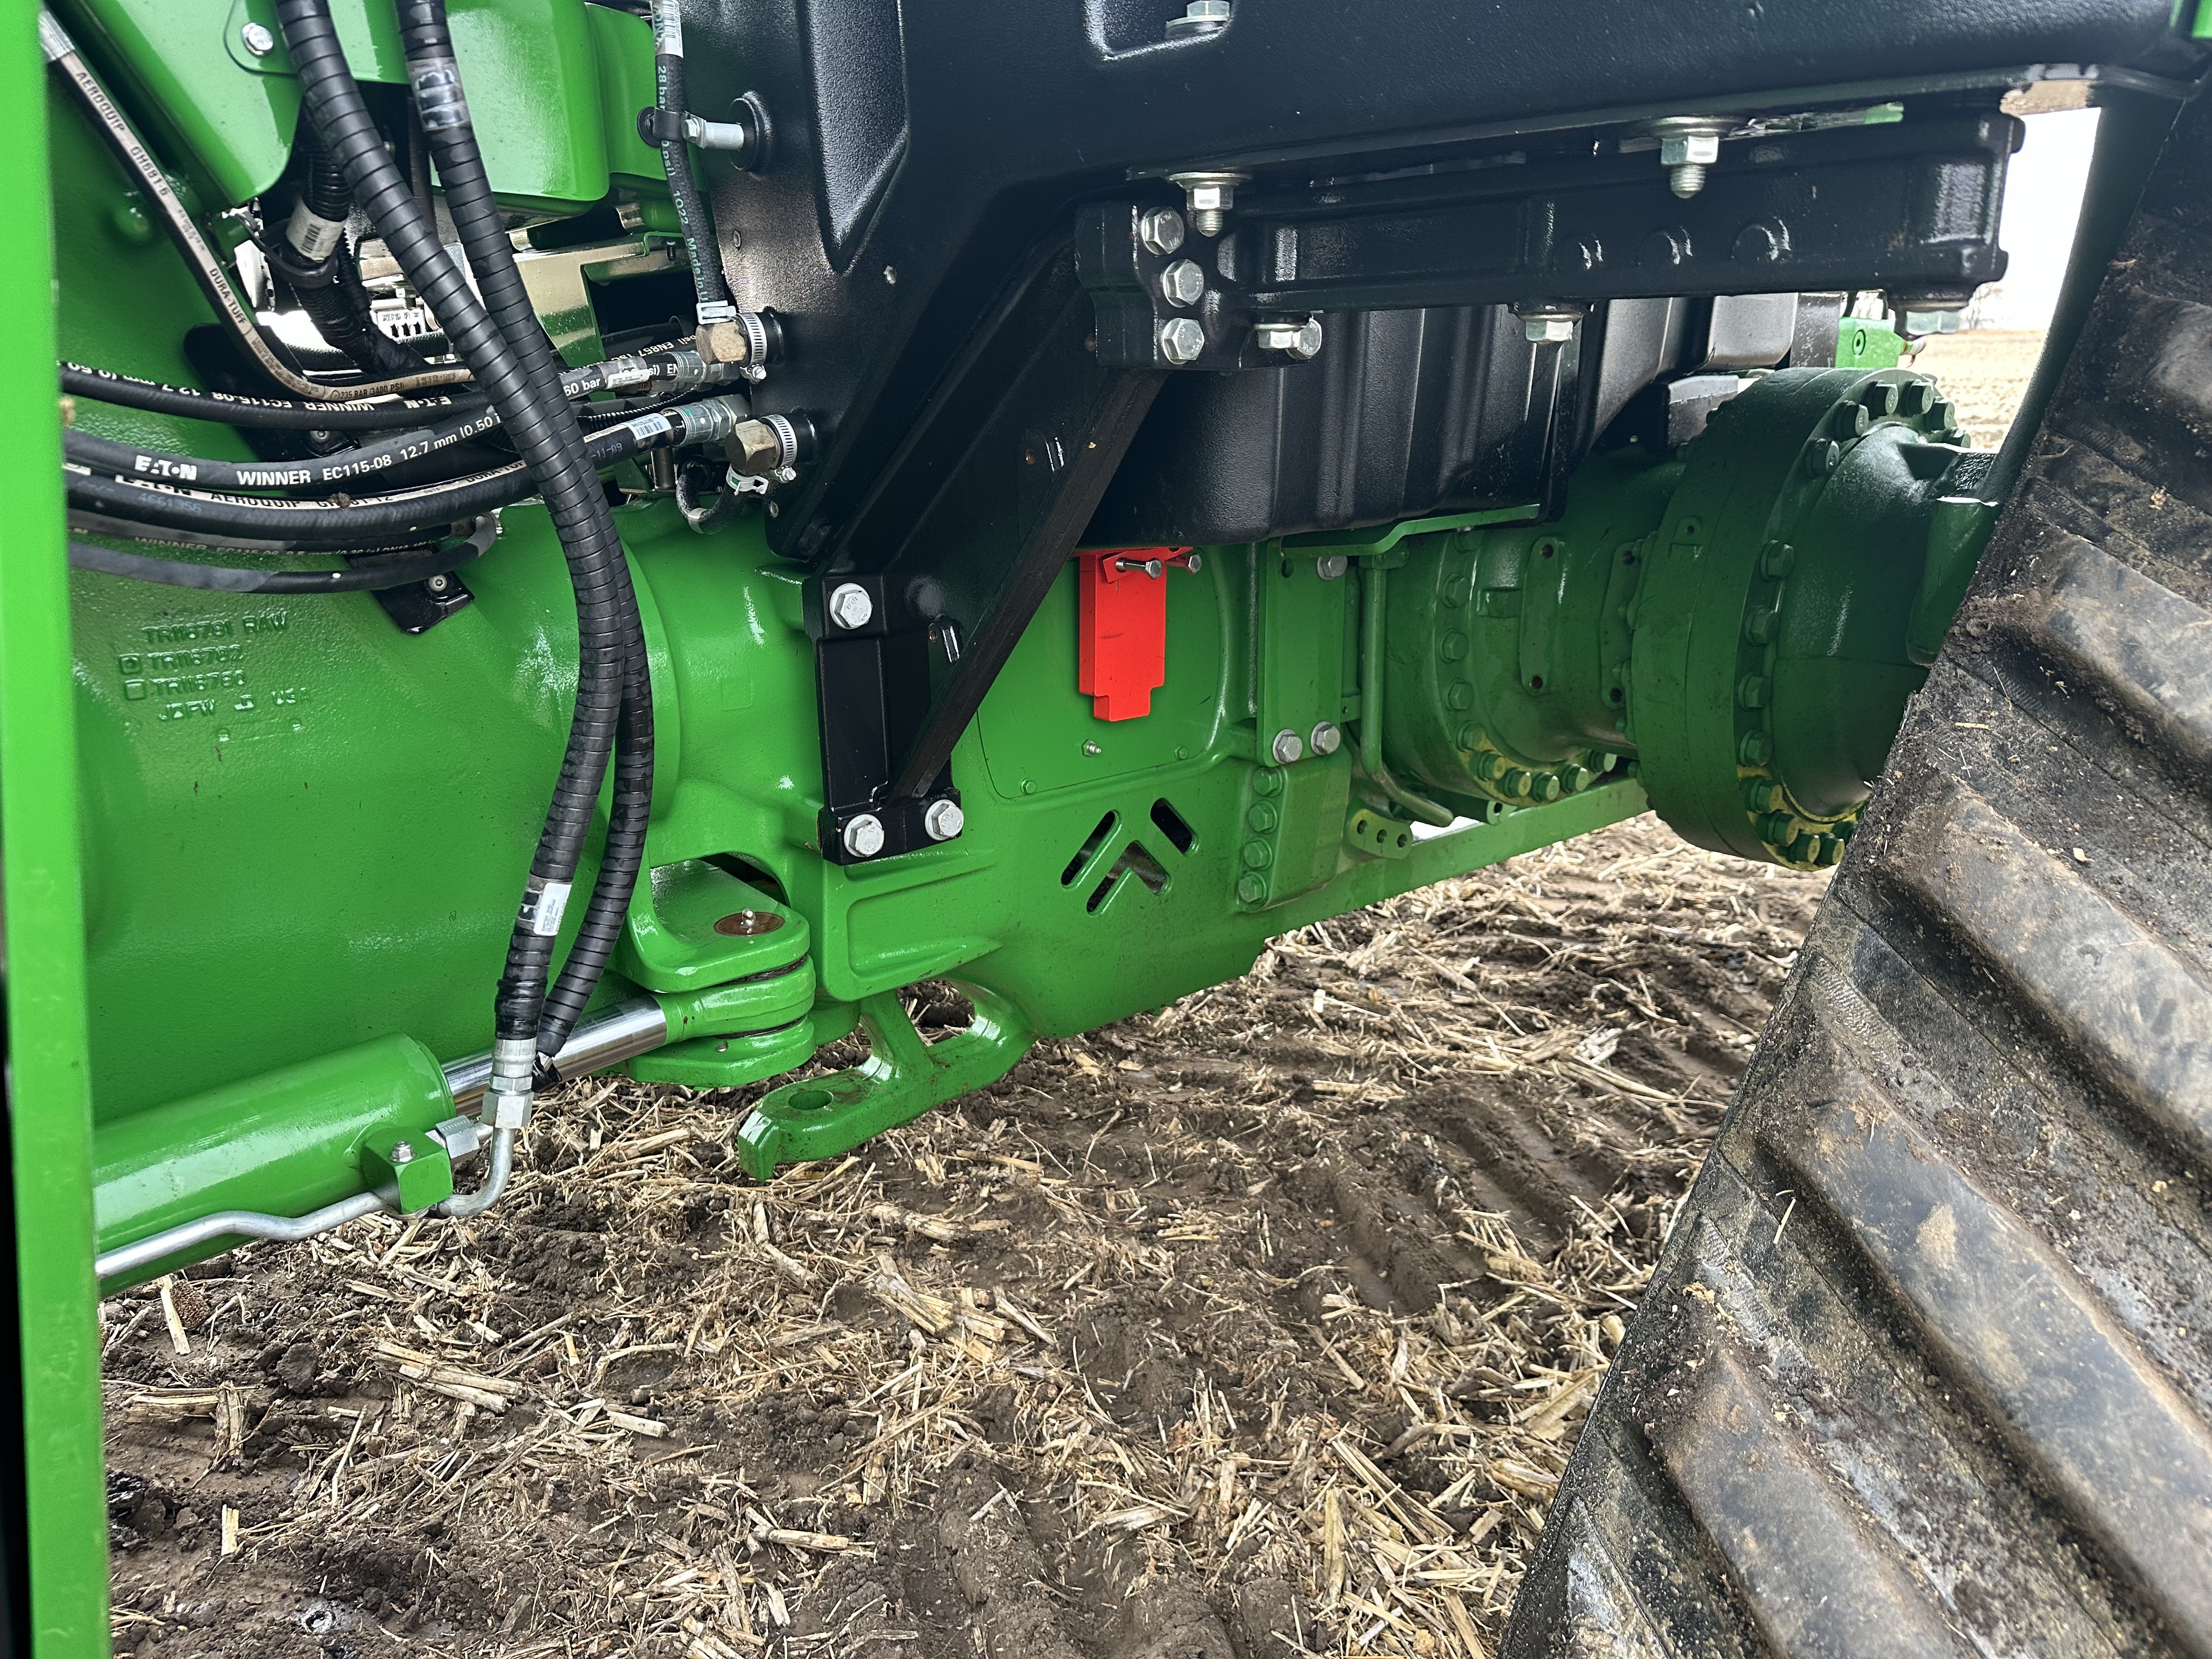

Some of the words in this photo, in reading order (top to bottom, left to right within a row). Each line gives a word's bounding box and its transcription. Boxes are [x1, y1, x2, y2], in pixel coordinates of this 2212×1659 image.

[658, 65, 667, 83] 28
[687, 237, 702, 275] Made
[696, 276, 705, 289] in
[76, 71, 126, 132] AEROQUIP
[209, 267, 247, 325] DURA-TUFF
[637, 341, 675, 357] EN857
[340, 391, 353, 399] 235
[354, 388, 368, 398] BAR
[581, 378, 601, 391] bar
[303, 401, 375, 411] WINNER
[236, 469, 312, 486] WINNER
[321, 454, 392, 481] EC115-08
[399, 440, 428, 460] 12.7
[433, 433, 458, 449] mm
[459, 415, 494, 439] (0.50
[242, 610, 289, 633] RAW
